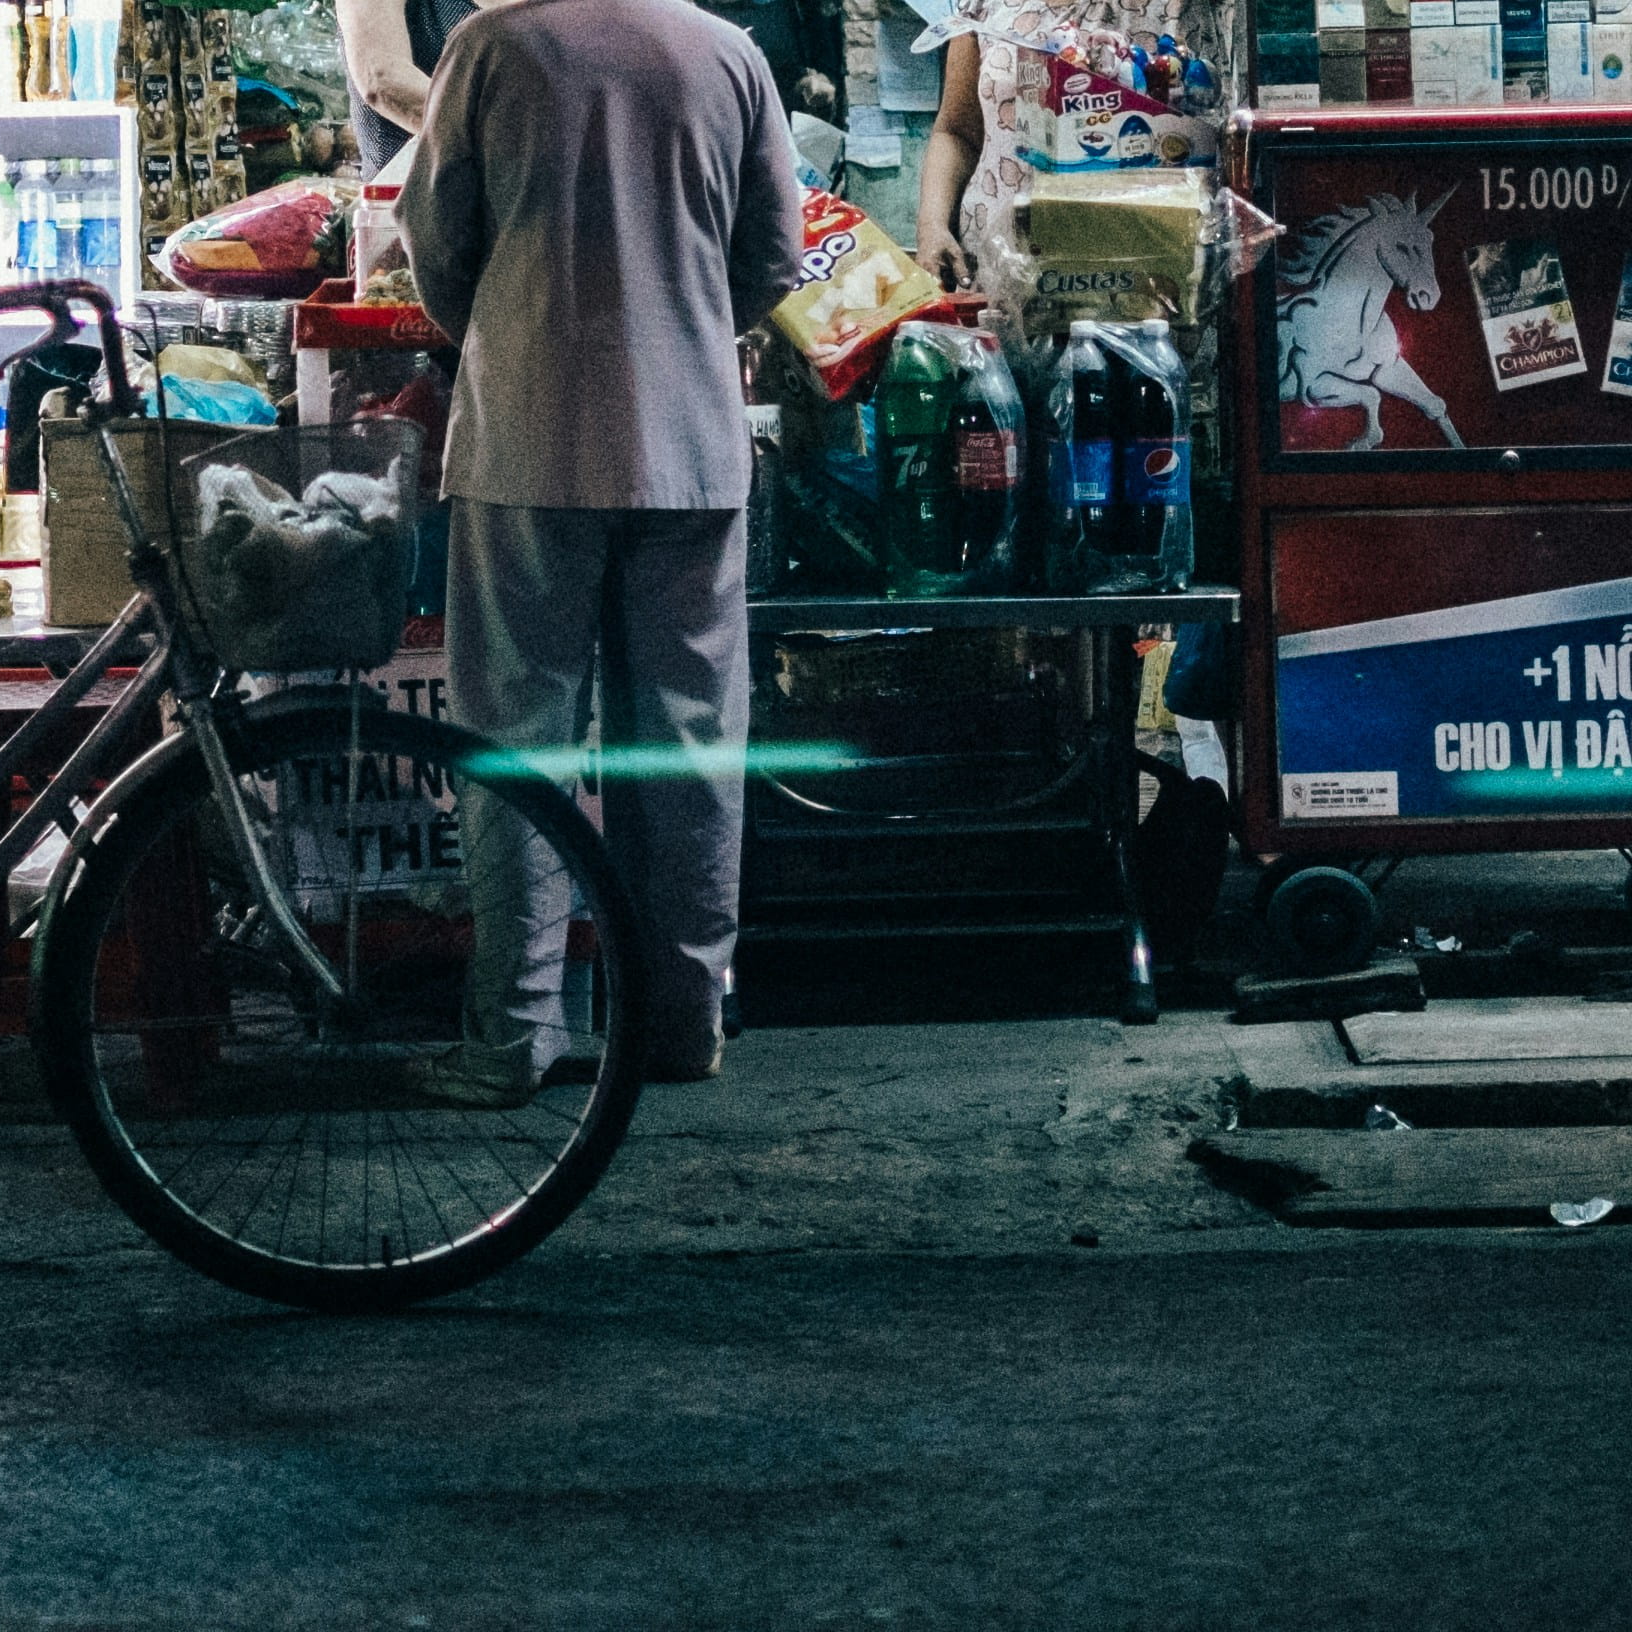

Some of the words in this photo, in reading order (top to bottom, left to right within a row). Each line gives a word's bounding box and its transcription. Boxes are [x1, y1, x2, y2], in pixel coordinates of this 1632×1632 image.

[1061, 90, 1122, 114] King
[1036, 268, 1136, 296] Custas
[1434, 721, 1512, 773] CHO
